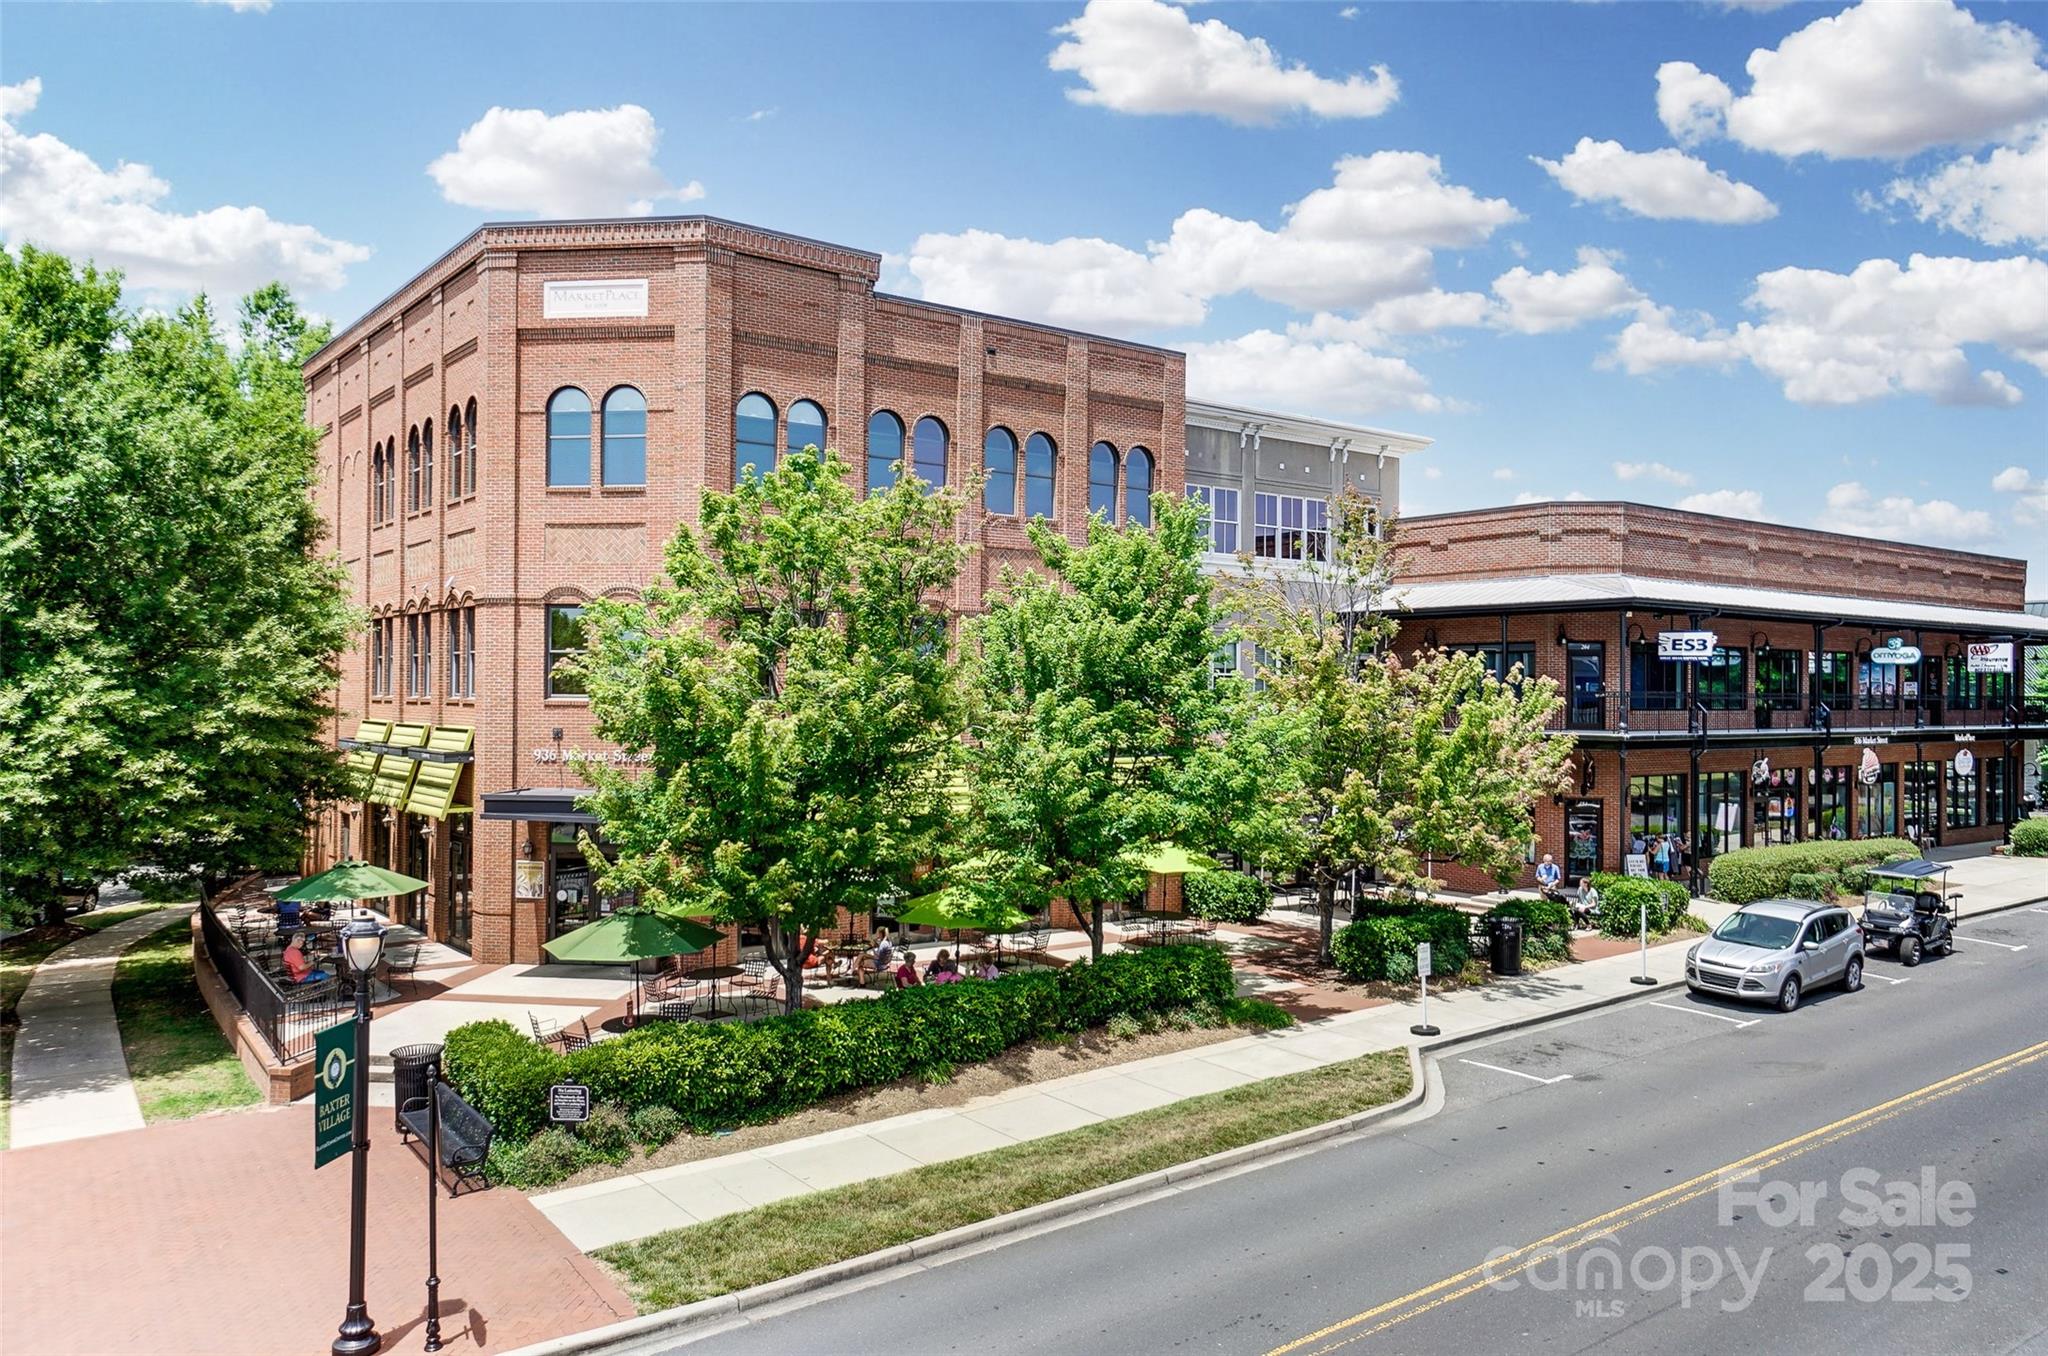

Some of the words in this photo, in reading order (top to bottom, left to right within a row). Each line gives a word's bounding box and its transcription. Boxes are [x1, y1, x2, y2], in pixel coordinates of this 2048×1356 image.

[1671, 638, 1708, 651] ES3
[533, 748, 557, 761] 936
[562, 748, 609, 761] Mrket
[319, 1093, 350, 1118] BAXTER
[318, 1107, 351, 1132] VILLAGE
